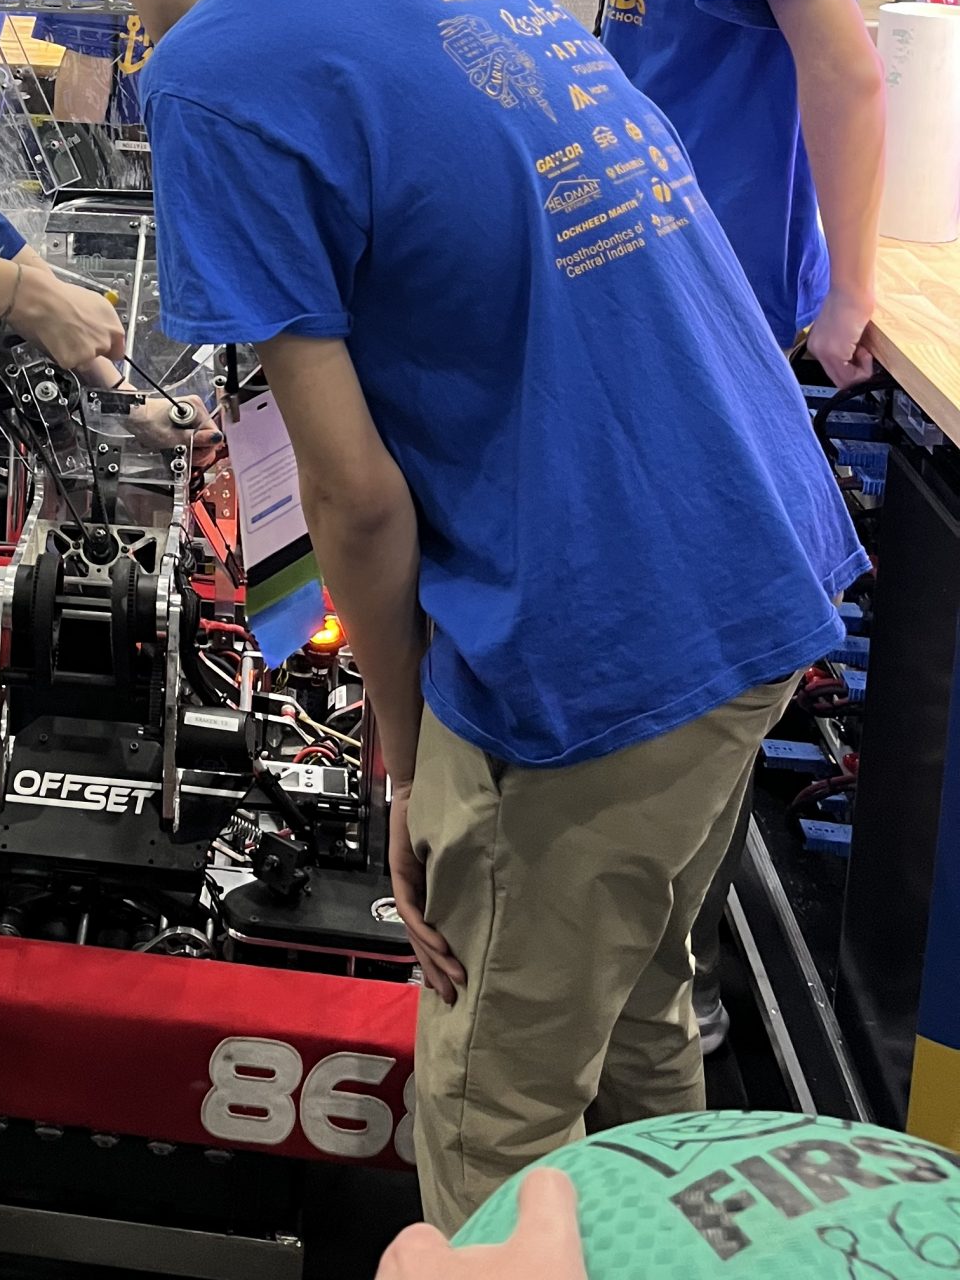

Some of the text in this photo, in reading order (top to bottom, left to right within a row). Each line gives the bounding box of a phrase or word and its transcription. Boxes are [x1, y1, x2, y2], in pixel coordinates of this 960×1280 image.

[536, 142, 584, 174] GAYLOR
[547, 181, 599, 211] HELDMAN
[556, 213, 608, 243] LOCKHEED
[608, 199, 639, 219] MARTIN
[555, 228, 635, 270] Prosthodontics
[634, 223, 646, 235] of
[566, 237, 646, 278] Central Indiana
[13, 769, 154, 814] OFFSET
[201, 1036, 417, 1166] 86
